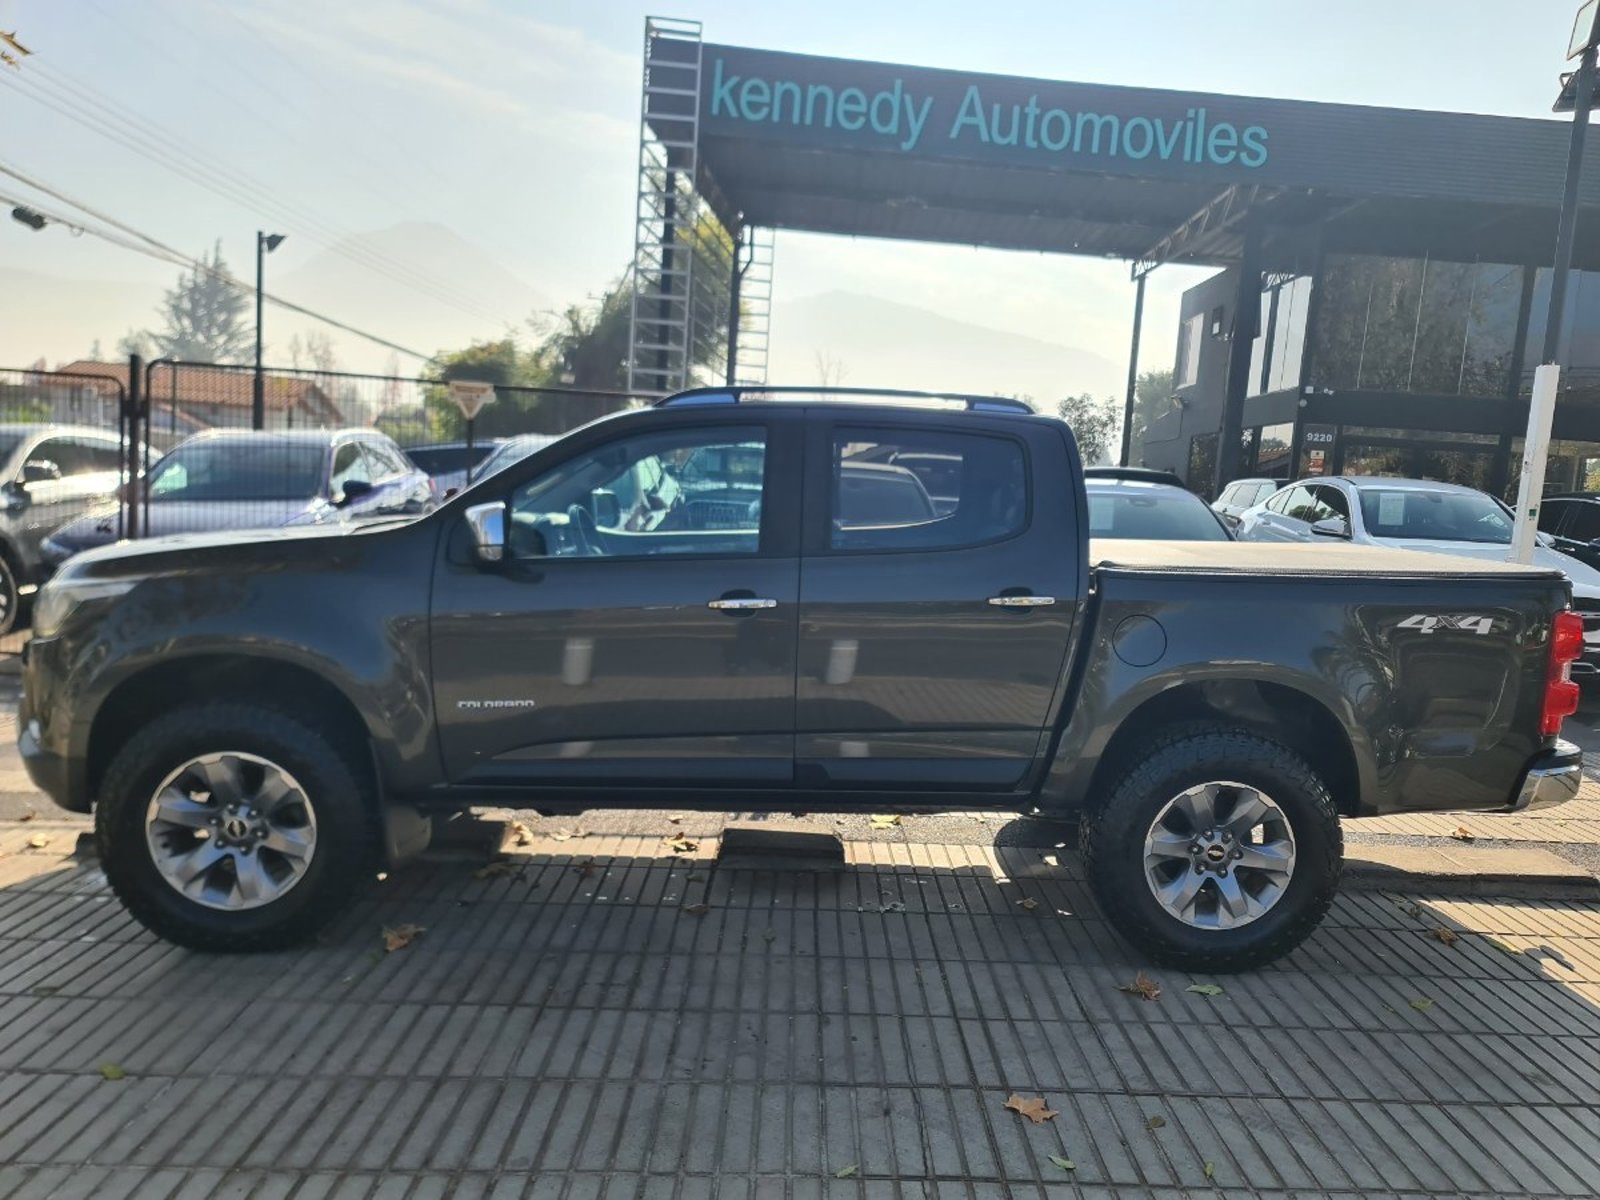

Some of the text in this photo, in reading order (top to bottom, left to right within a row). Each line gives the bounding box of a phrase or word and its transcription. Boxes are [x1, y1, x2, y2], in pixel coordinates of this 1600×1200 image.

[711, 59, 1269, 167] kennedy Automoviles
[1306, 432, 1333, 442] 9220
